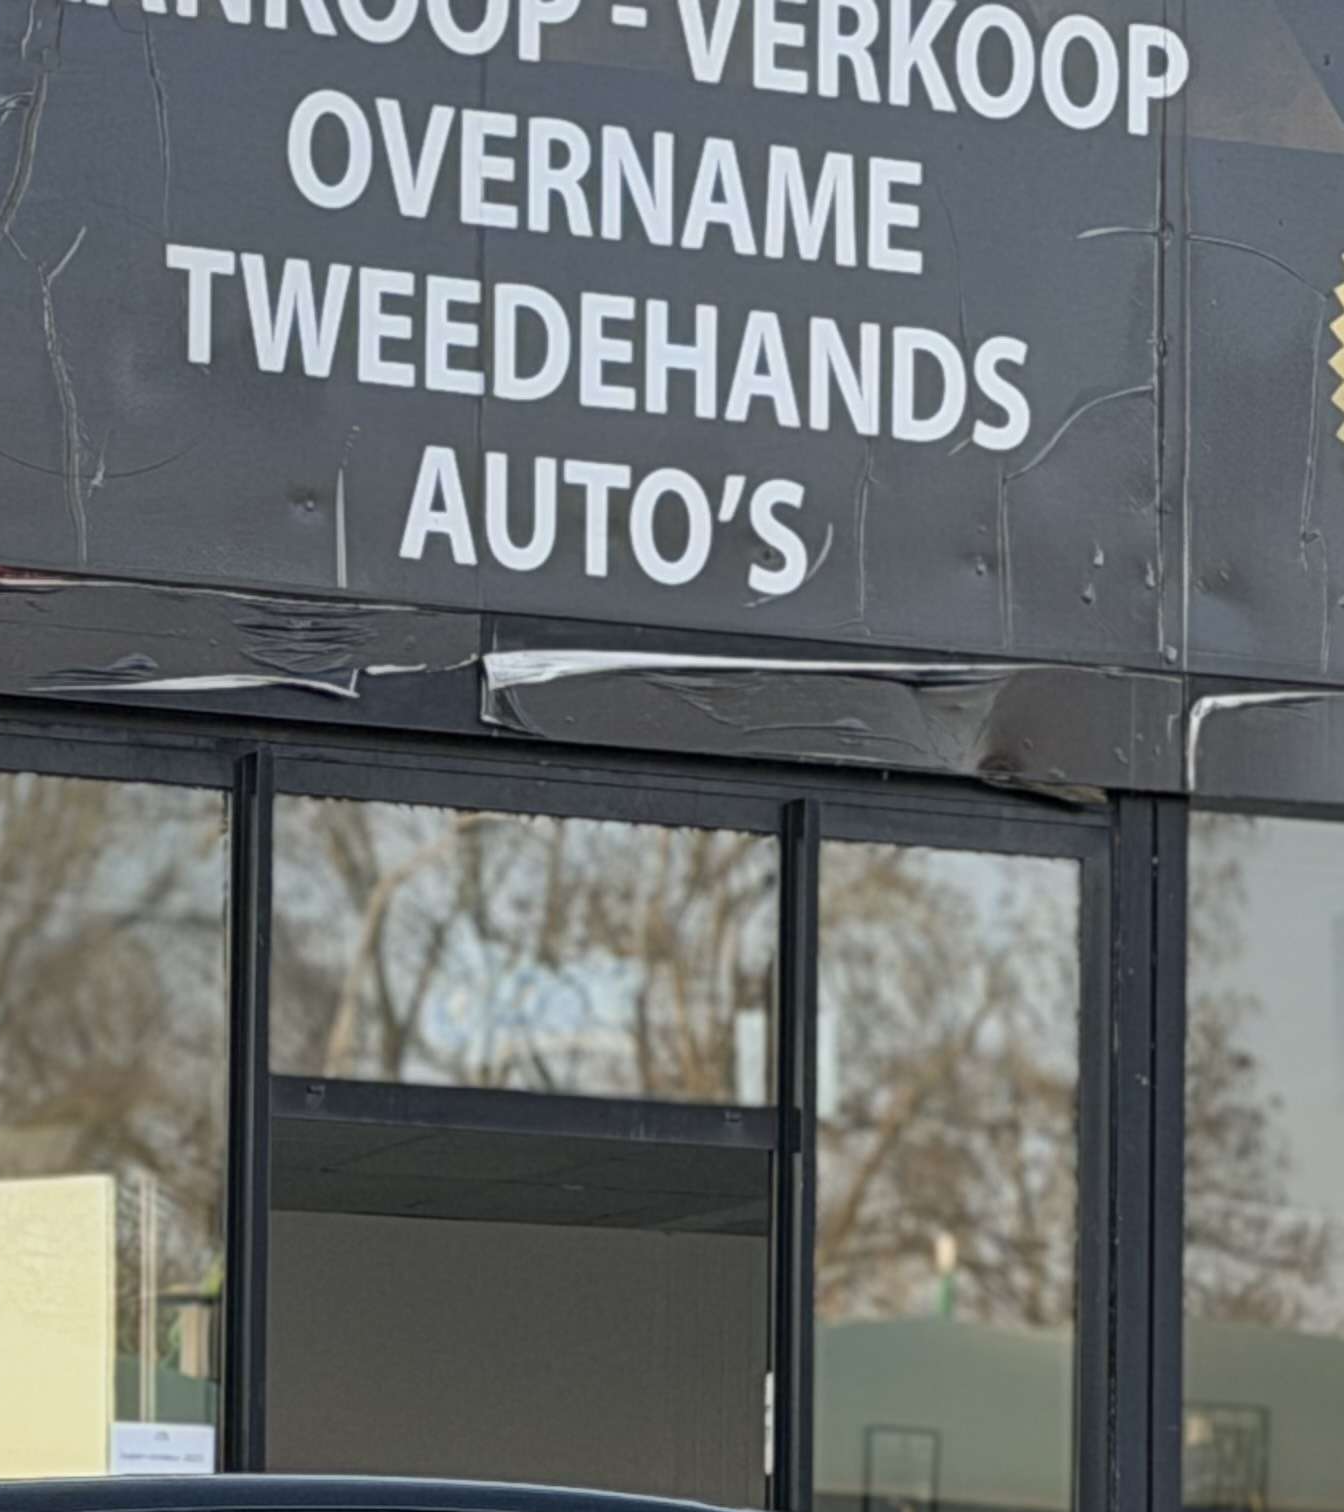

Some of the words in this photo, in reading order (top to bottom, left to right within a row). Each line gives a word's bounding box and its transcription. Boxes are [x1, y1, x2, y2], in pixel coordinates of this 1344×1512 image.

[677, 0, 1189, 135] VERKOOP
[288, 89, 923, 274] OVERNAME
[165, 243, 1031, 450] TWEEDEHANDS
[399, 444, 807, 596] AUTO'S
